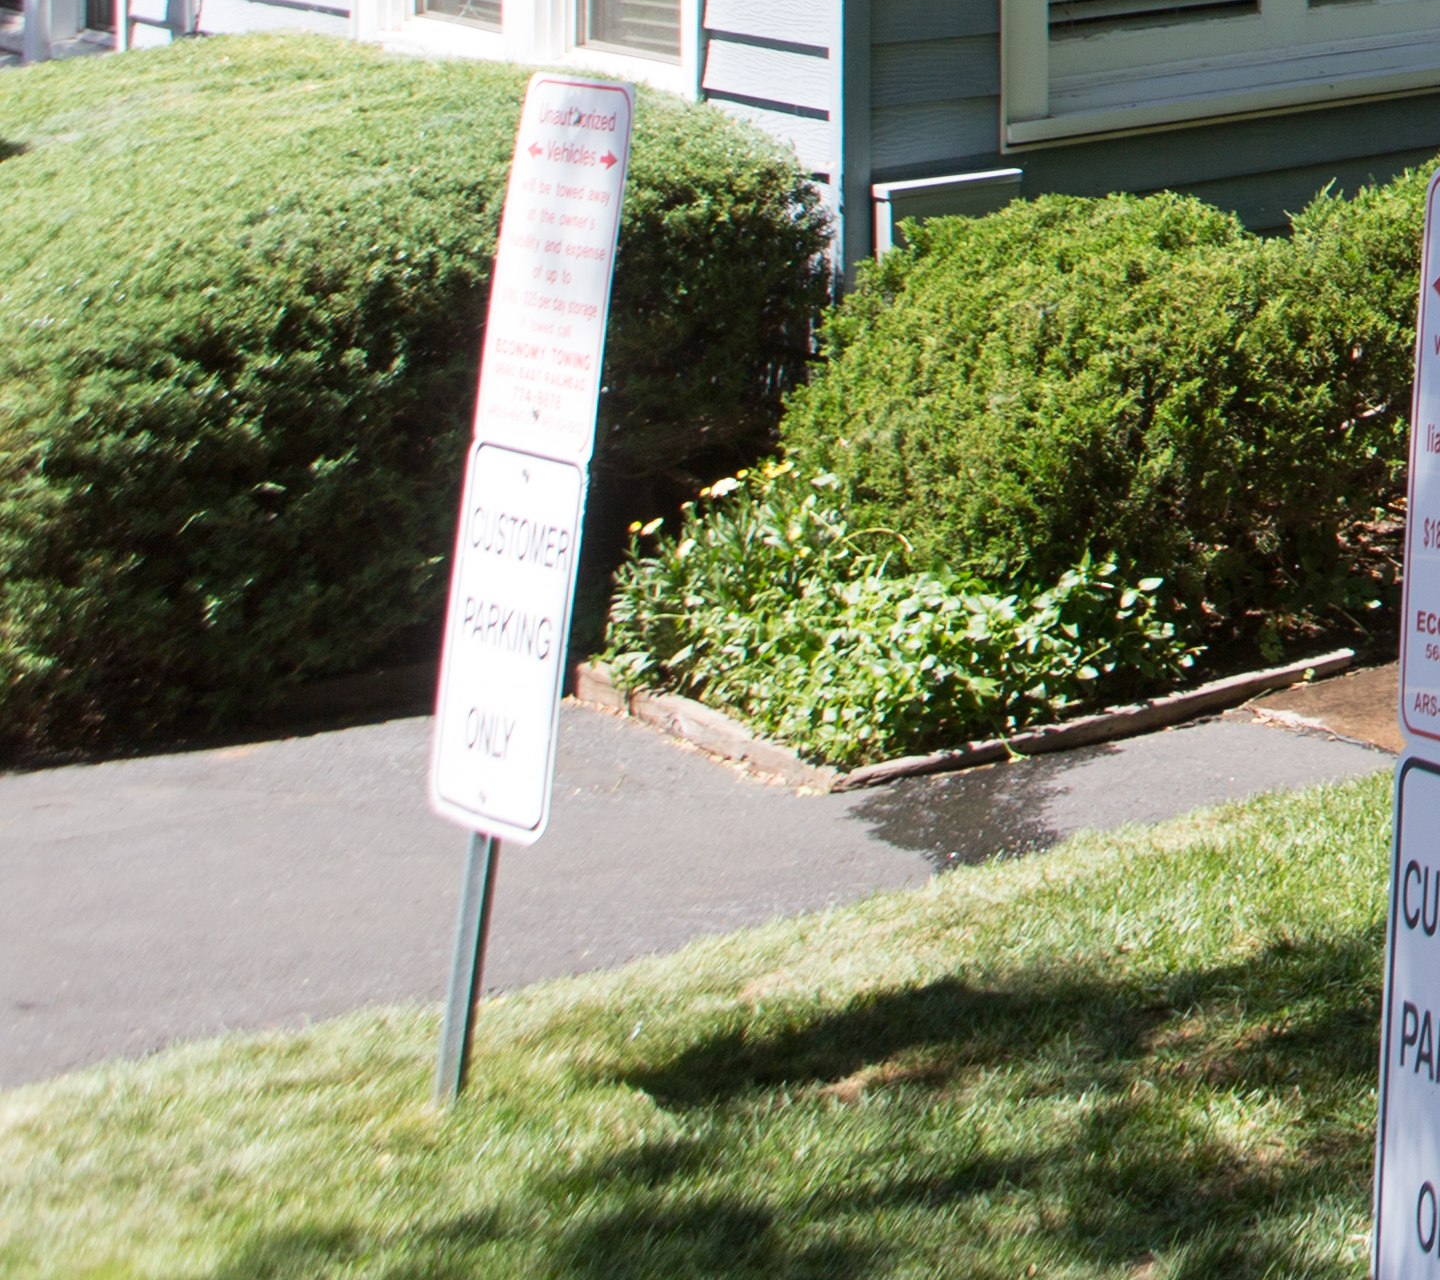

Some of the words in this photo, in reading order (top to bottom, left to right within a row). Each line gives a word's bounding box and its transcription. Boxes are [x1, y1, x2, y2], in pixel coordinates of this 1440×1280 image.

[548, 140, 597, 166] Vehicles
[539, 178, 552, 196] be
[556, 181, 586, 200] towed
[588, 188, 612, 207] away
[540, 207, 556, 225] the
[544, 238, 564, 255] and
[565, 243, 606, 262] expense
[470, 506, 571, 572] CUSTOMER
[463, 596, 553, 662] PARKING
[465, 706, 517, 761] ONLY
